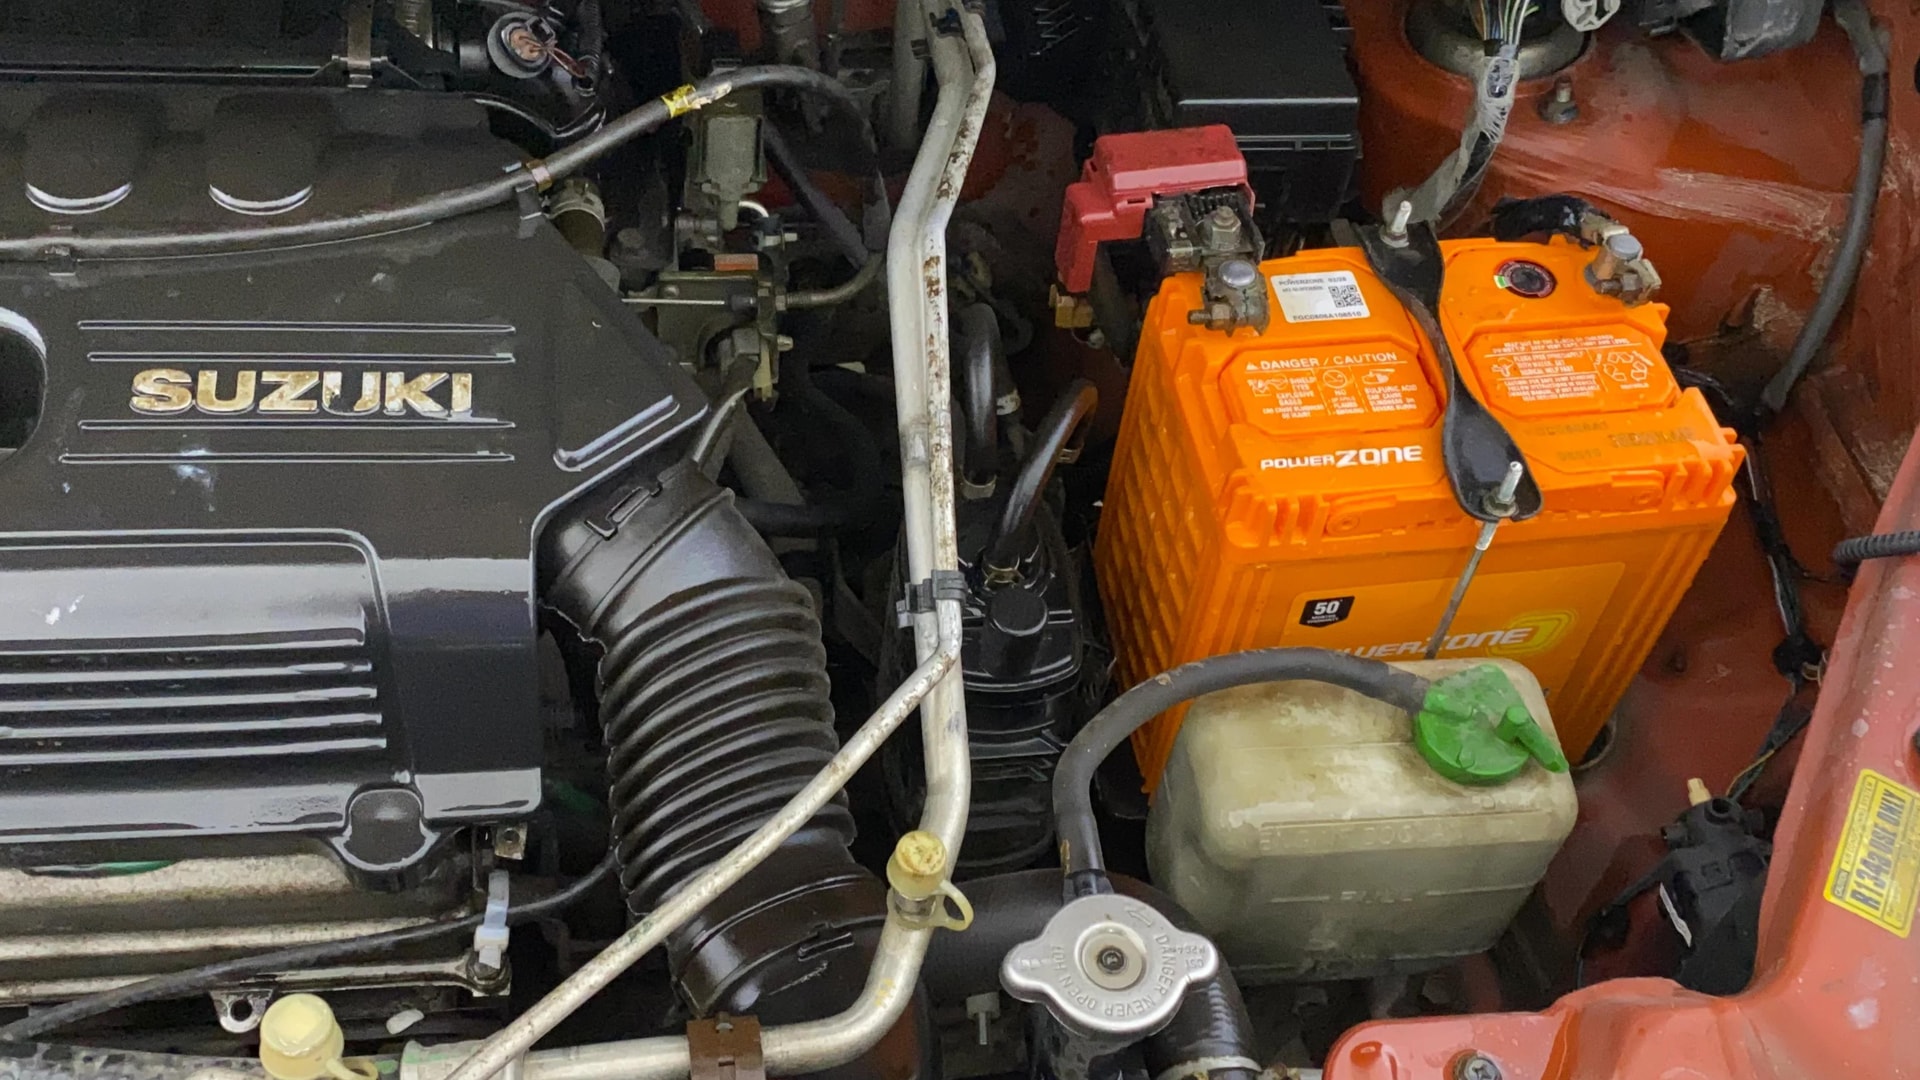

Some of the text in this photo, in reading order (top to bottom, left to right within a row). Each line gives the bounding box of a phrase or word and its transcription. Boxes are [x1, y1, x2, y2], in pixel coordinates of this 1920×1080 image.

[1261, 357, 1319, 370] DANGER
[1333, 352, 1397, 365] CAUTION
[129, 368, 473, 416] SUZUKI
[1260, 445, 1423, 471] POWERZONE
[1313, 600, 1340, 616] 50
[1876, 788, 1906, 826] ONLY
[1869, 822, 1897, 856] USE
[1850, 850, 1892, 911] R134a
[1154, 933, 1177, 997] DANGER
[1061, 974, 1098, 1011] OPEN
[1104, 995, 1156, 1017] NEVER
